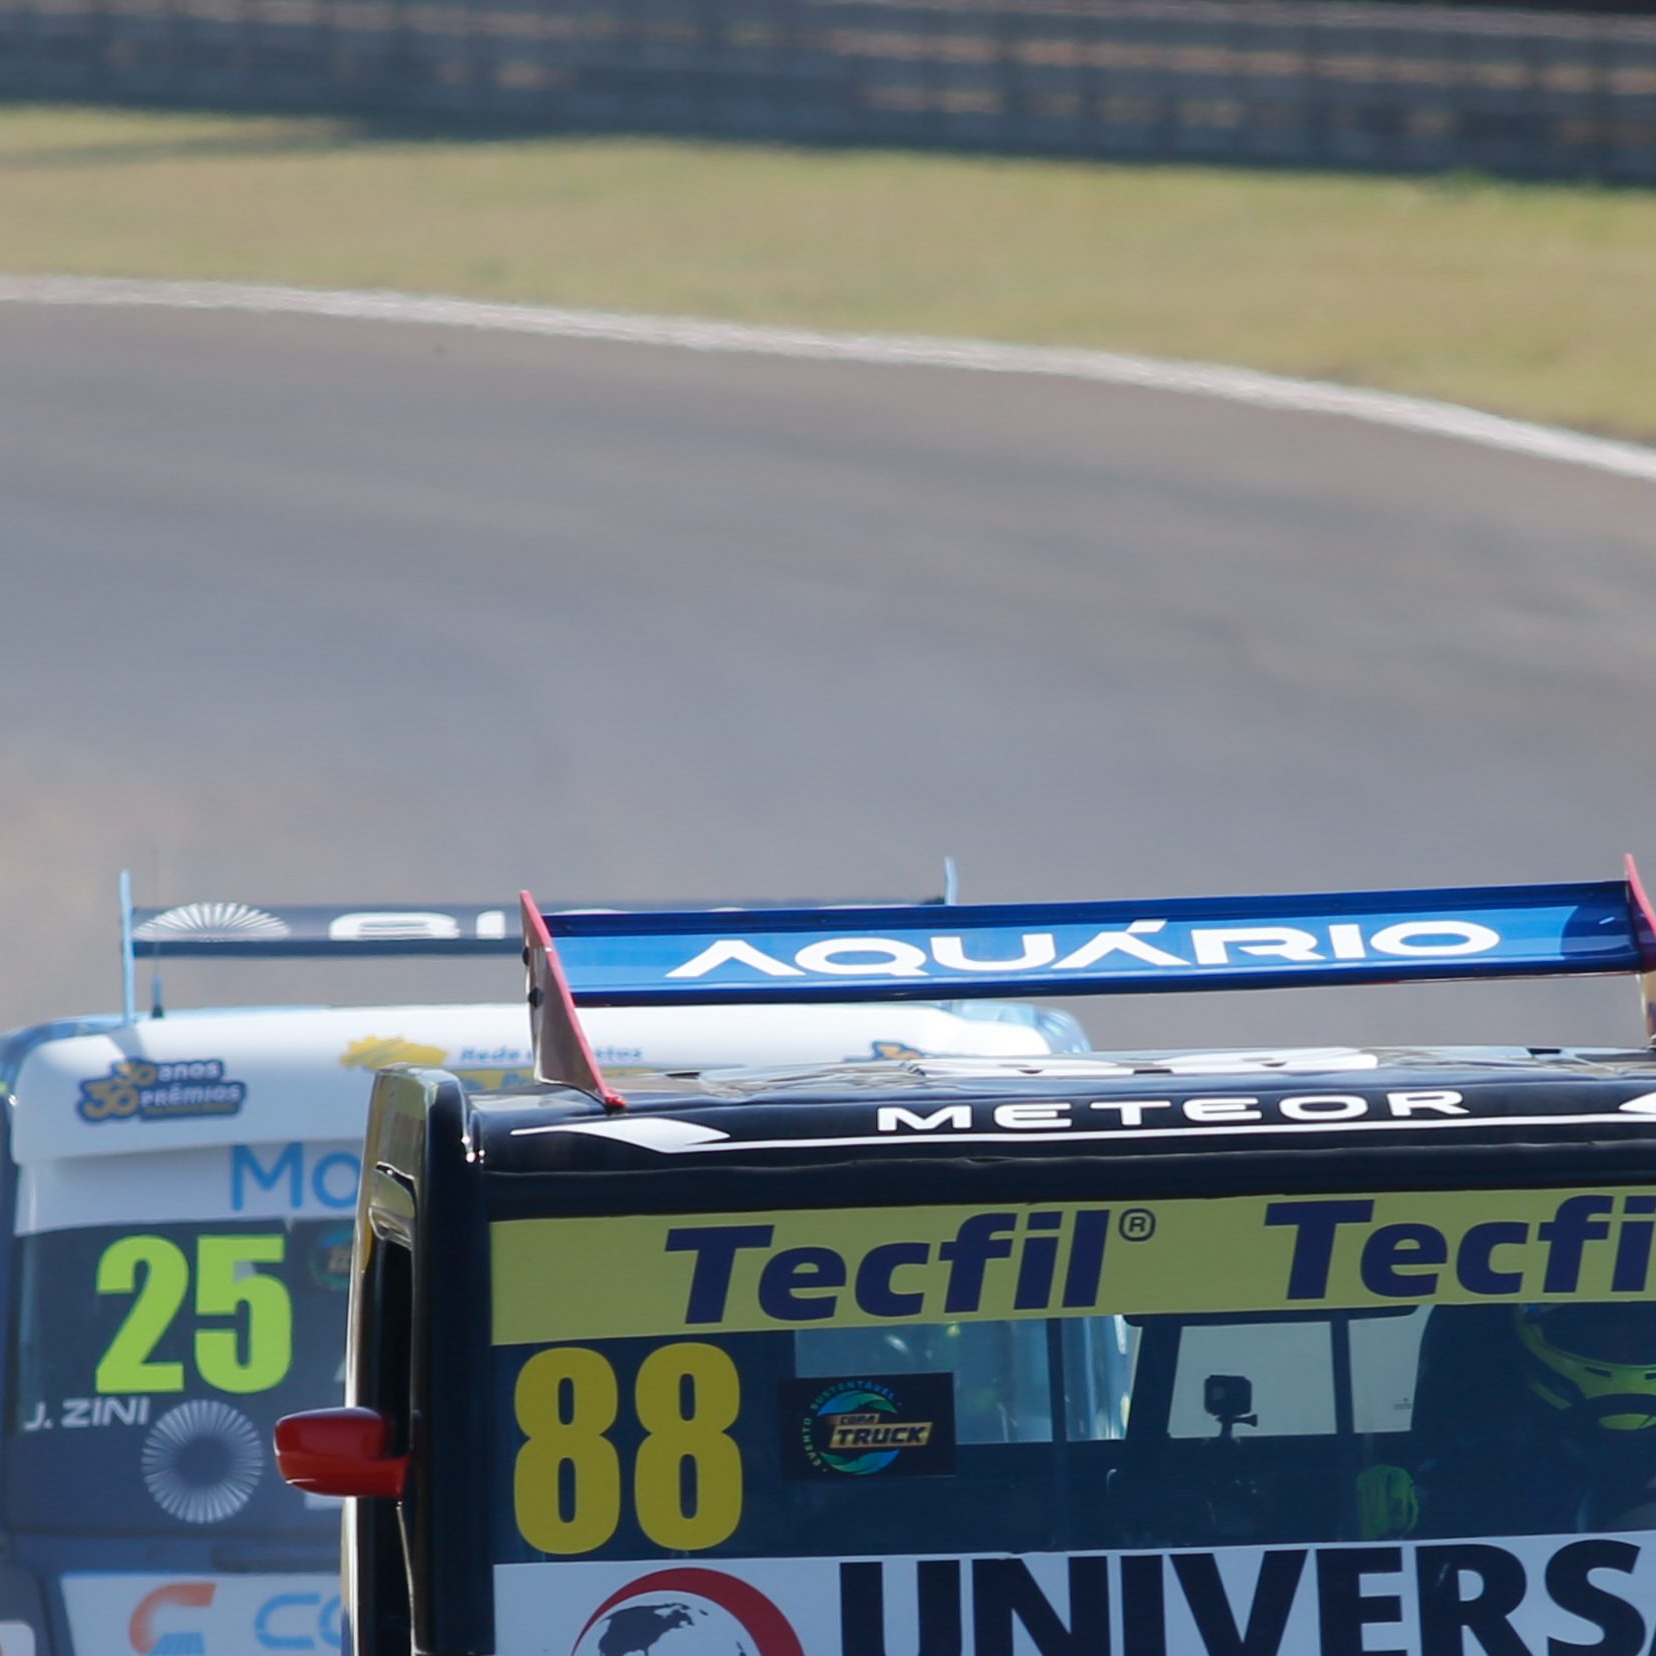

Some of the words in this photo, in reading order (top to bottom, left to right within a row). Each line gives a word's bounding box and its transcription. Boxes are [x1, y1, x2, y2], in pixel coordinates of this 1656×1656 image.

[665, 919, 1500, 978] AQUÁRIO
[878, 1091, 1470, 1130] METEOR
[95, 1234, 292, 1393] 25
[24, 1402, 52, 1431] J.
[837, 1426, 927, 1446] TRUCK
[514, 1342, 743, 1555] 88
